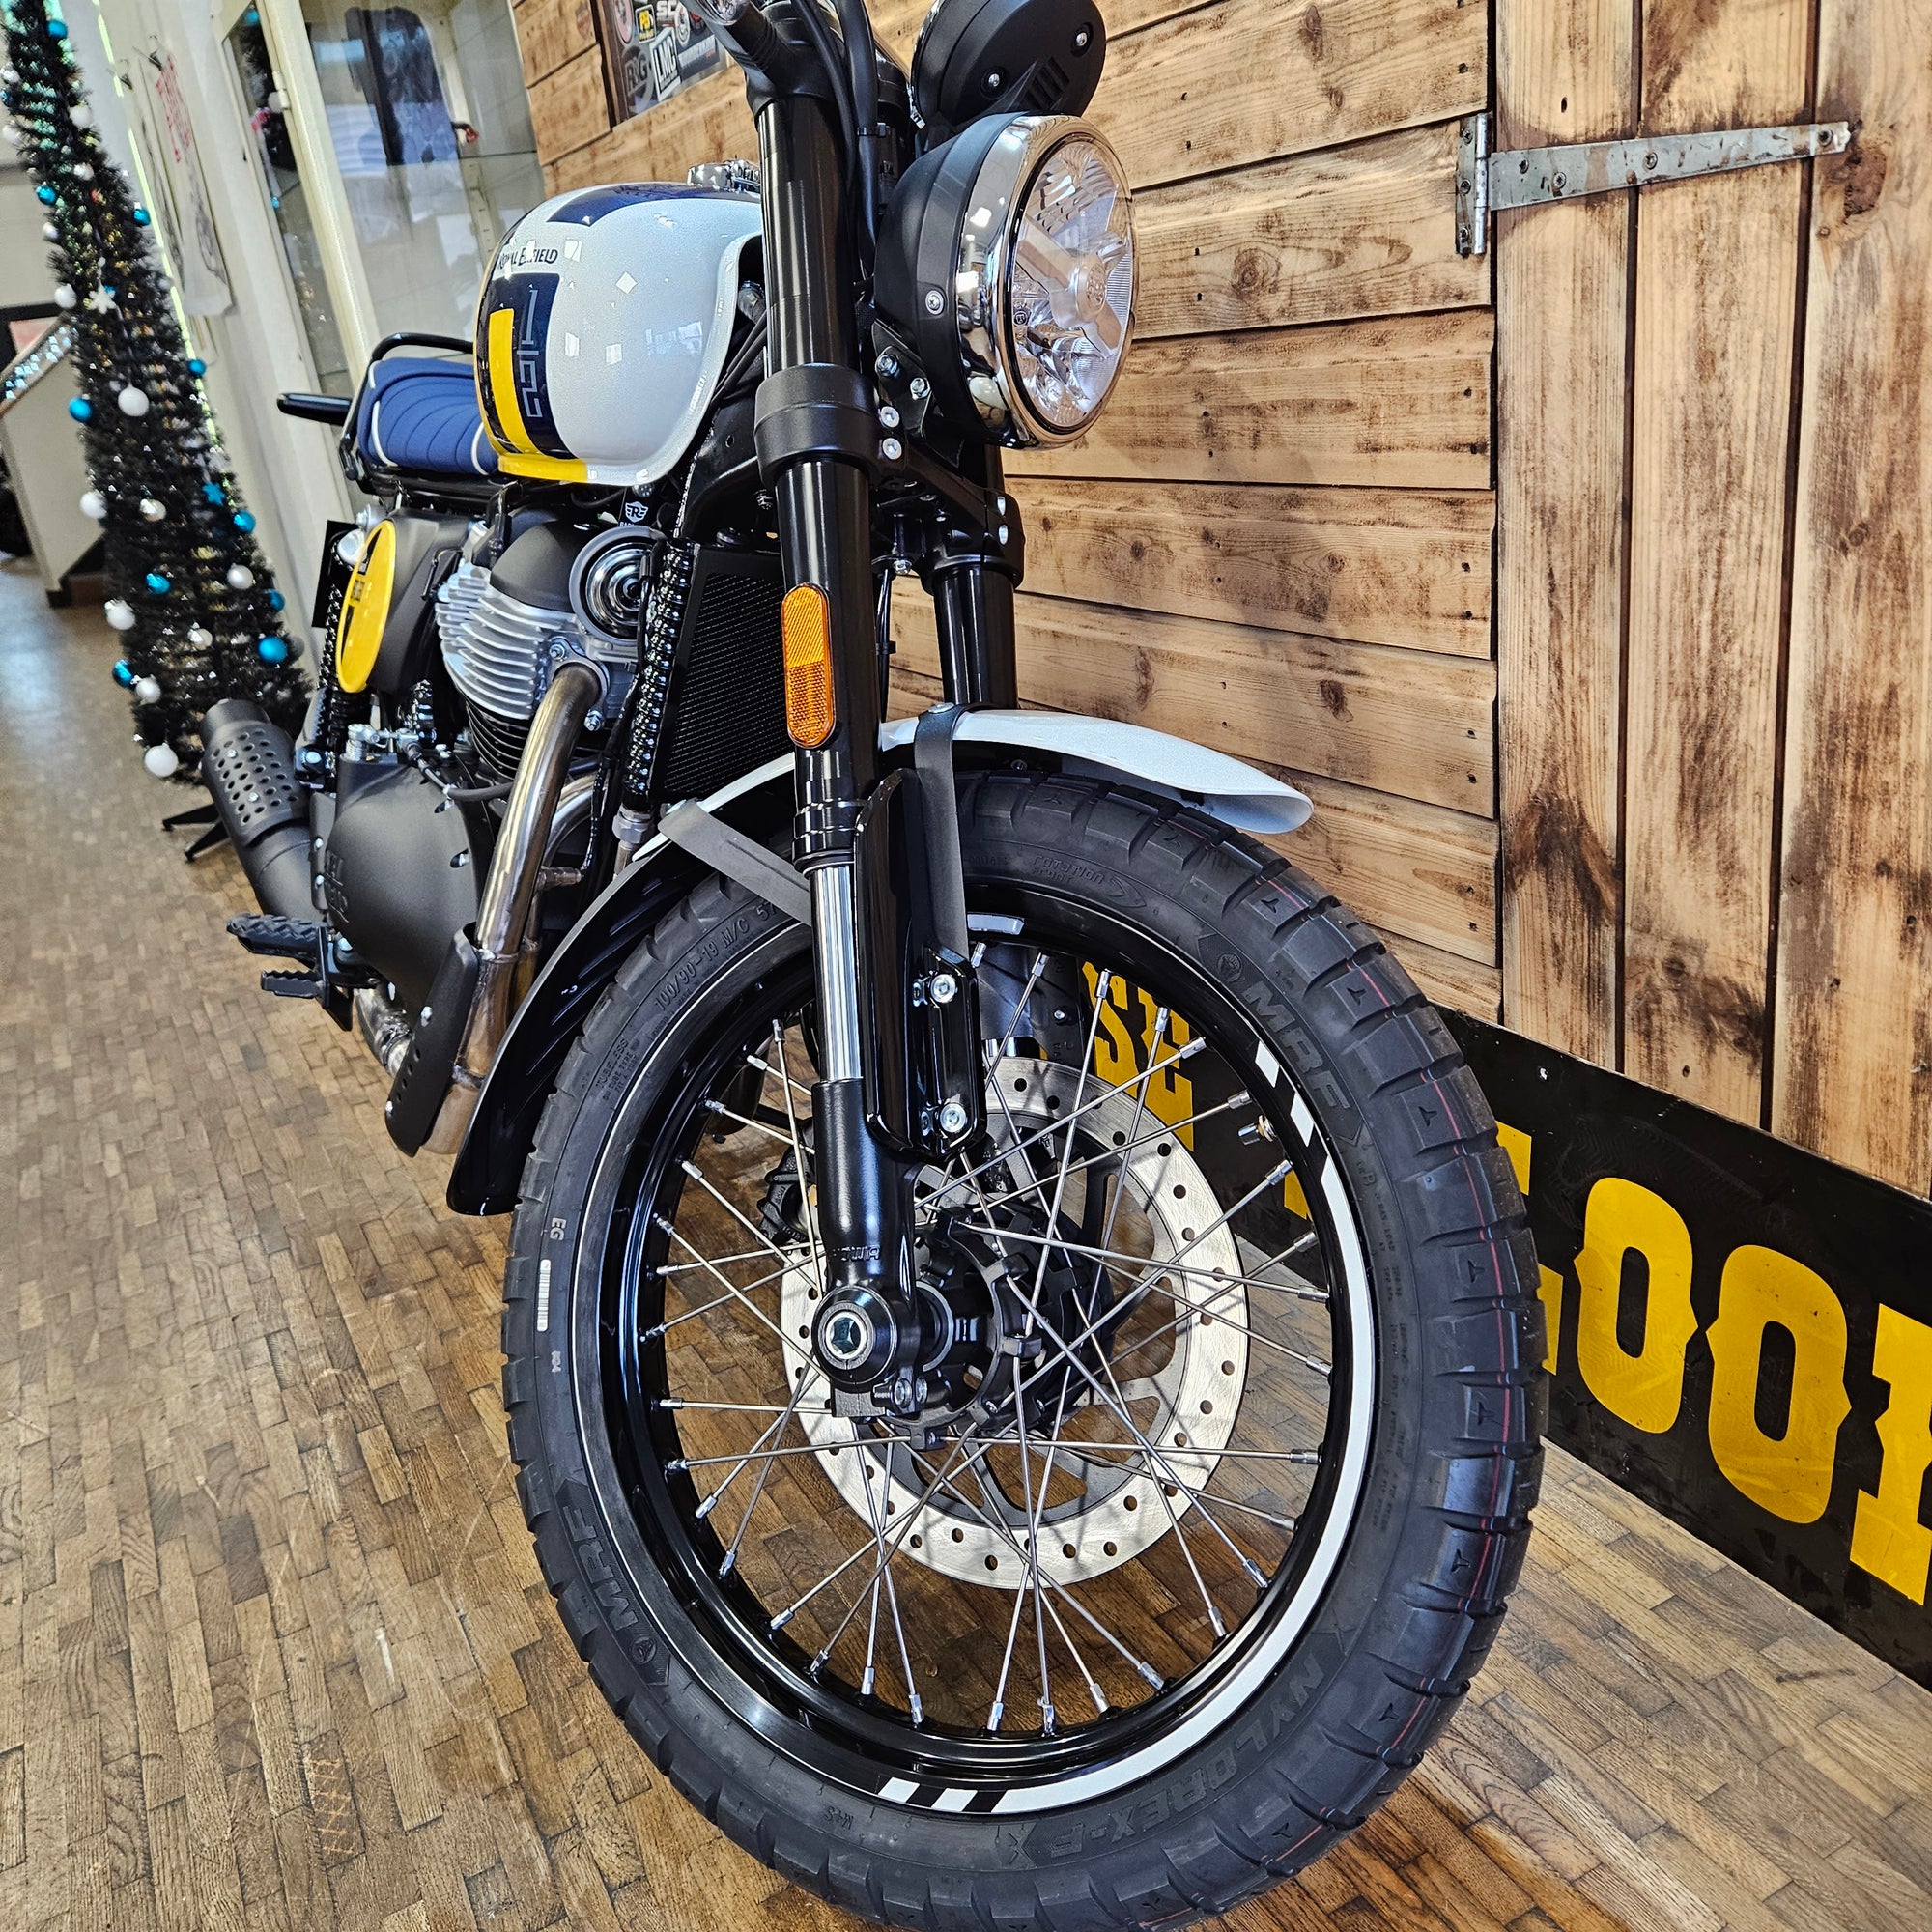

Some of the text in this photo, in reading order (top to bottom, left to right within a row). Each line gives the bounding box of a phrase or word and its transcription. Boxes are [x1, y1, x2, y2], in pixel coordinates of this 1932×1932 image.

[518, 247, 558, 267] EFIELD
[721, 917, 750, 949] M/C
[1082, 961, 1194, 1151] SE
[1241, 980, 1350, 1110] MRF
[562, 1505, 639, 1632] MRF
[1051, 1653, 1324, 1858] NYLOREX-F
